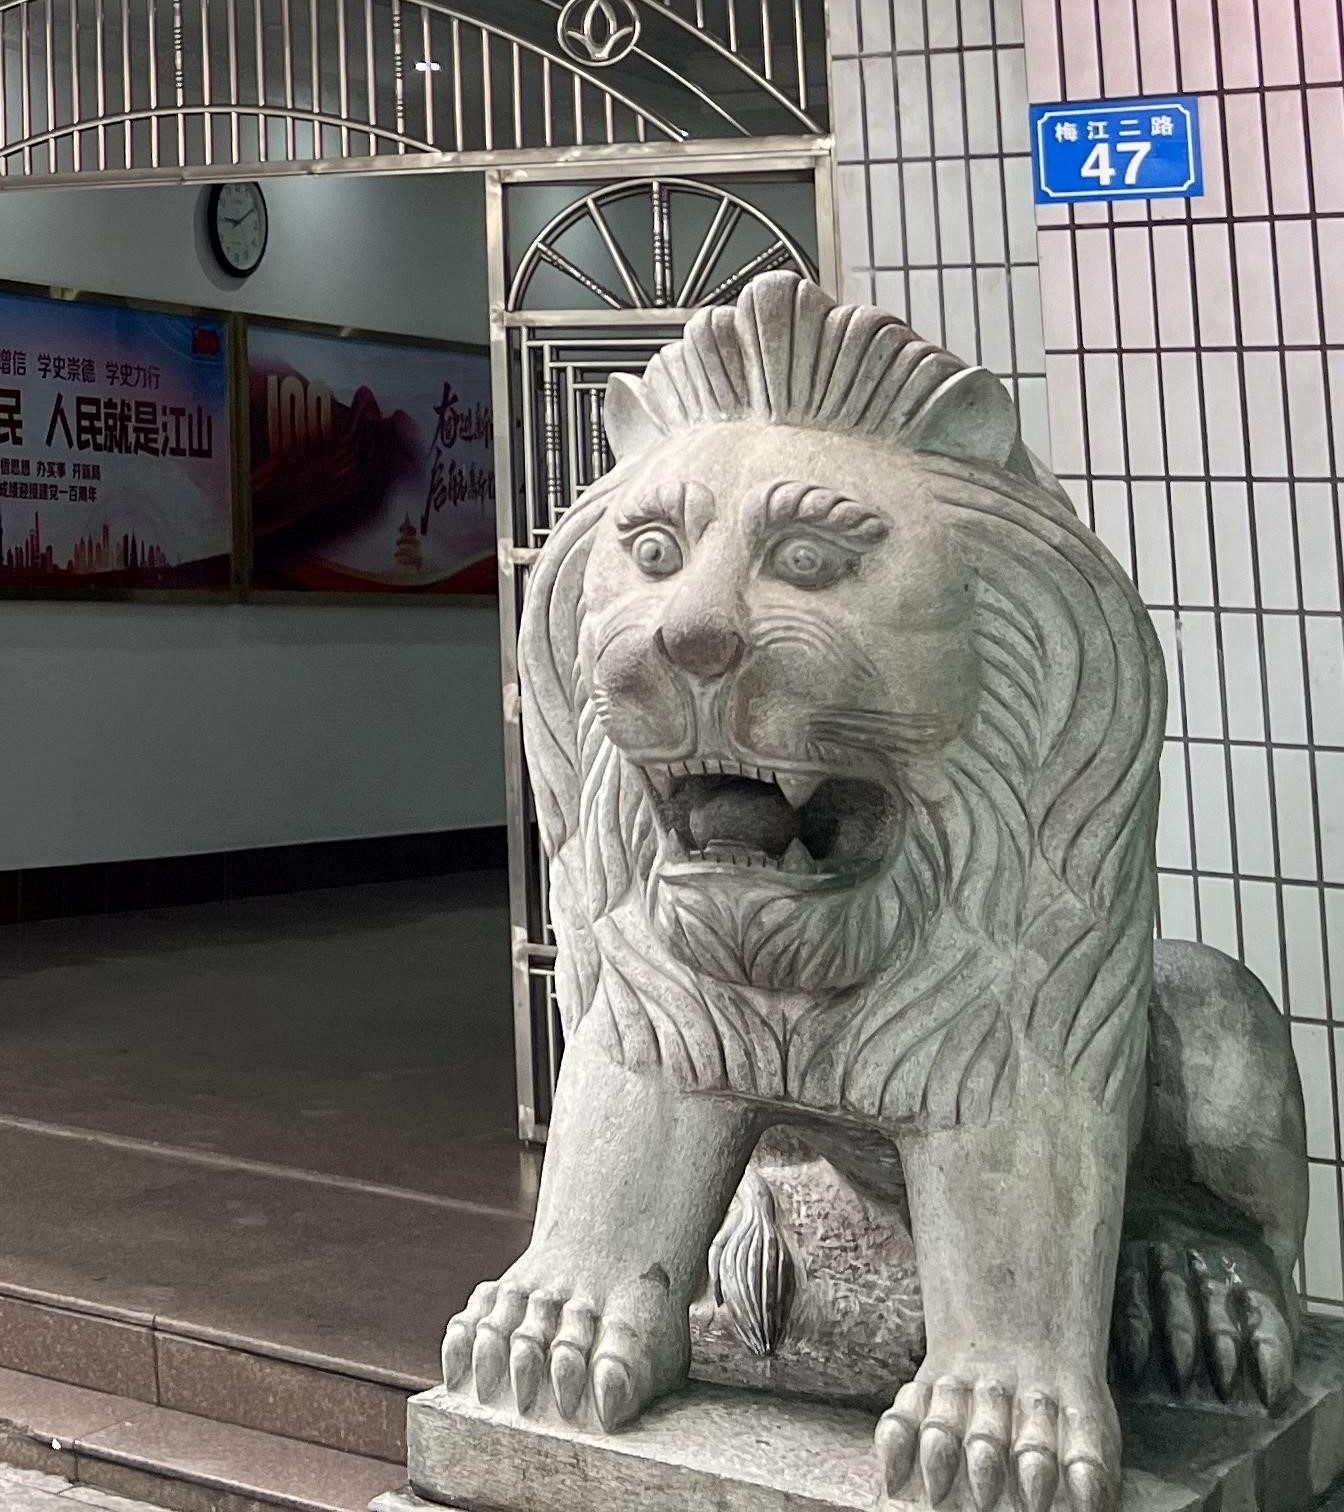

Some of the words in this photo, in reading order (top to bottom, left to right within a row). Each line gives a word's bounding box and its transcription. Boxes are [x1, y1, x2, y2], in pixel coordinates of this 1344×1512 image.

[1054, 116, 1174, 143] 梅江二路
[1080, 141, 1151, 186] 47
[37, 353, 96, 383] 学史崇德
[105, 361, 161, 389] 学史力行
[45, 392, 212, 458] 人民就是江山
[36, 460, 67, 479] 办实事
